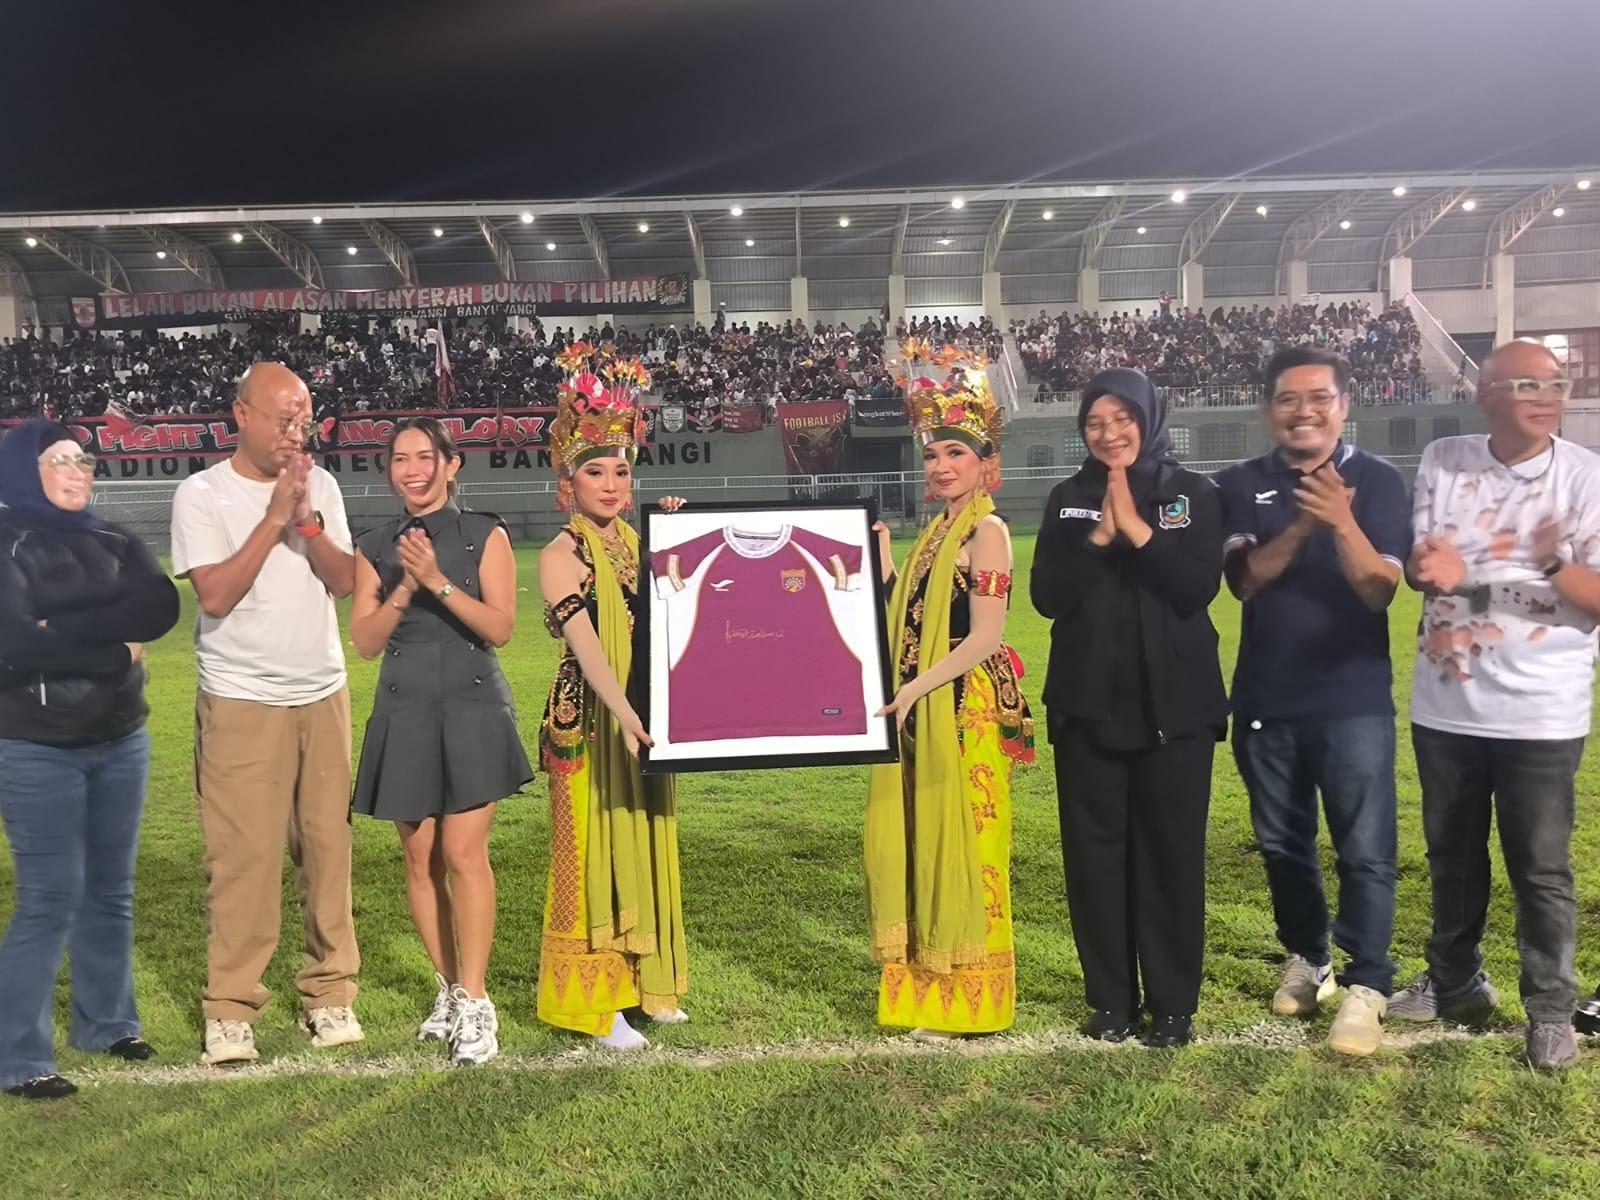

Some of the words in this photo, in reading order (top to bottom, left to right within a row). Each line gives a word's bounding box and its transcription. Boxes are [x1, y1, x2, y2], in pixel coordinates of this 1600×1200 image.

[103, 293, 177, 319] LELAH
[183, 290, 255, 315] BUKAN
[262, 289, 347, 311] ALASAN
[356, 286, 473, 310] MENYERAH
[481, 282, 552, 303] BUKAN
[564, 279, 657, 304] PILIHAN
[397, 416, 545, 446] LORY
[783, 415, 830, 431] FOOTBALL
[94, 456, 206, 478] ADION
